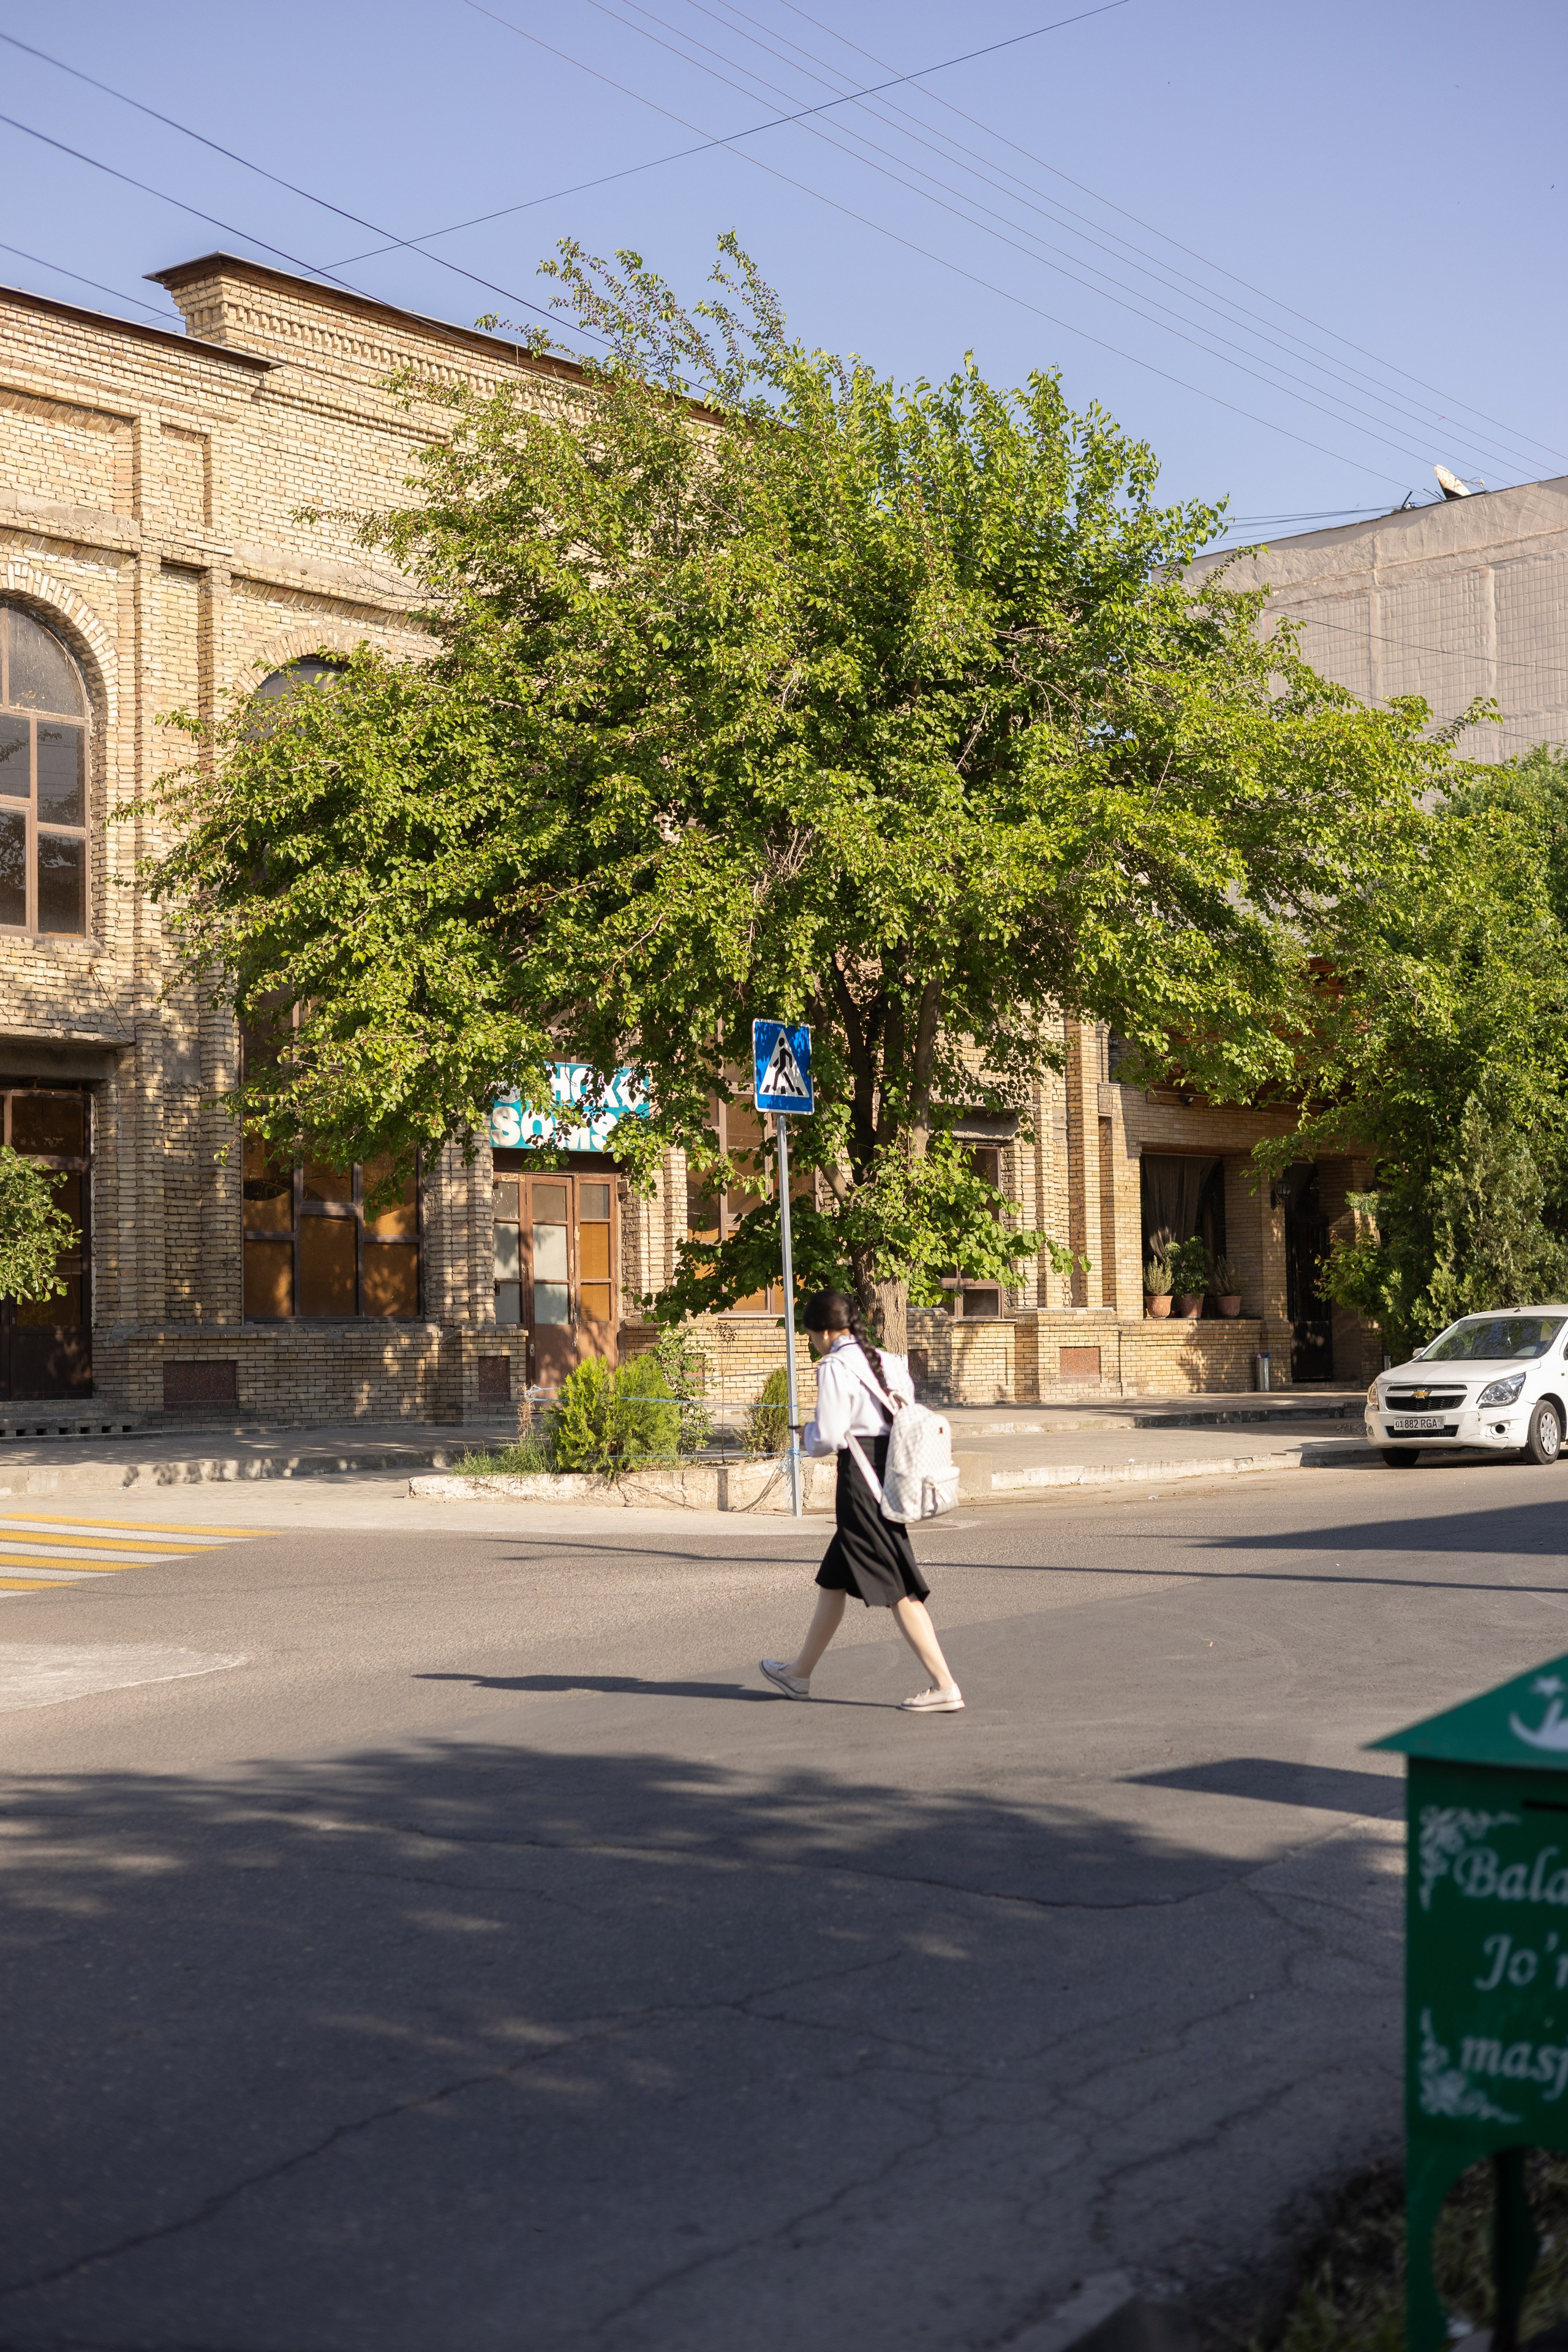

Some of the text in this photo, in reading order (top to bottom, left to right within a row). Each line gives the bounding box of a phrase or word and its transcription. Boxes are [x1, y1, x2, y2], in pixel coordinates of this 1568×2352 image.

[530, 1065, 619, 1108] HOX
[491, 1106, 620, 1151] SOMS
[1404, 1419, 1419, 1428] 882
[1421, 1419, 1438, 1428] RGA
